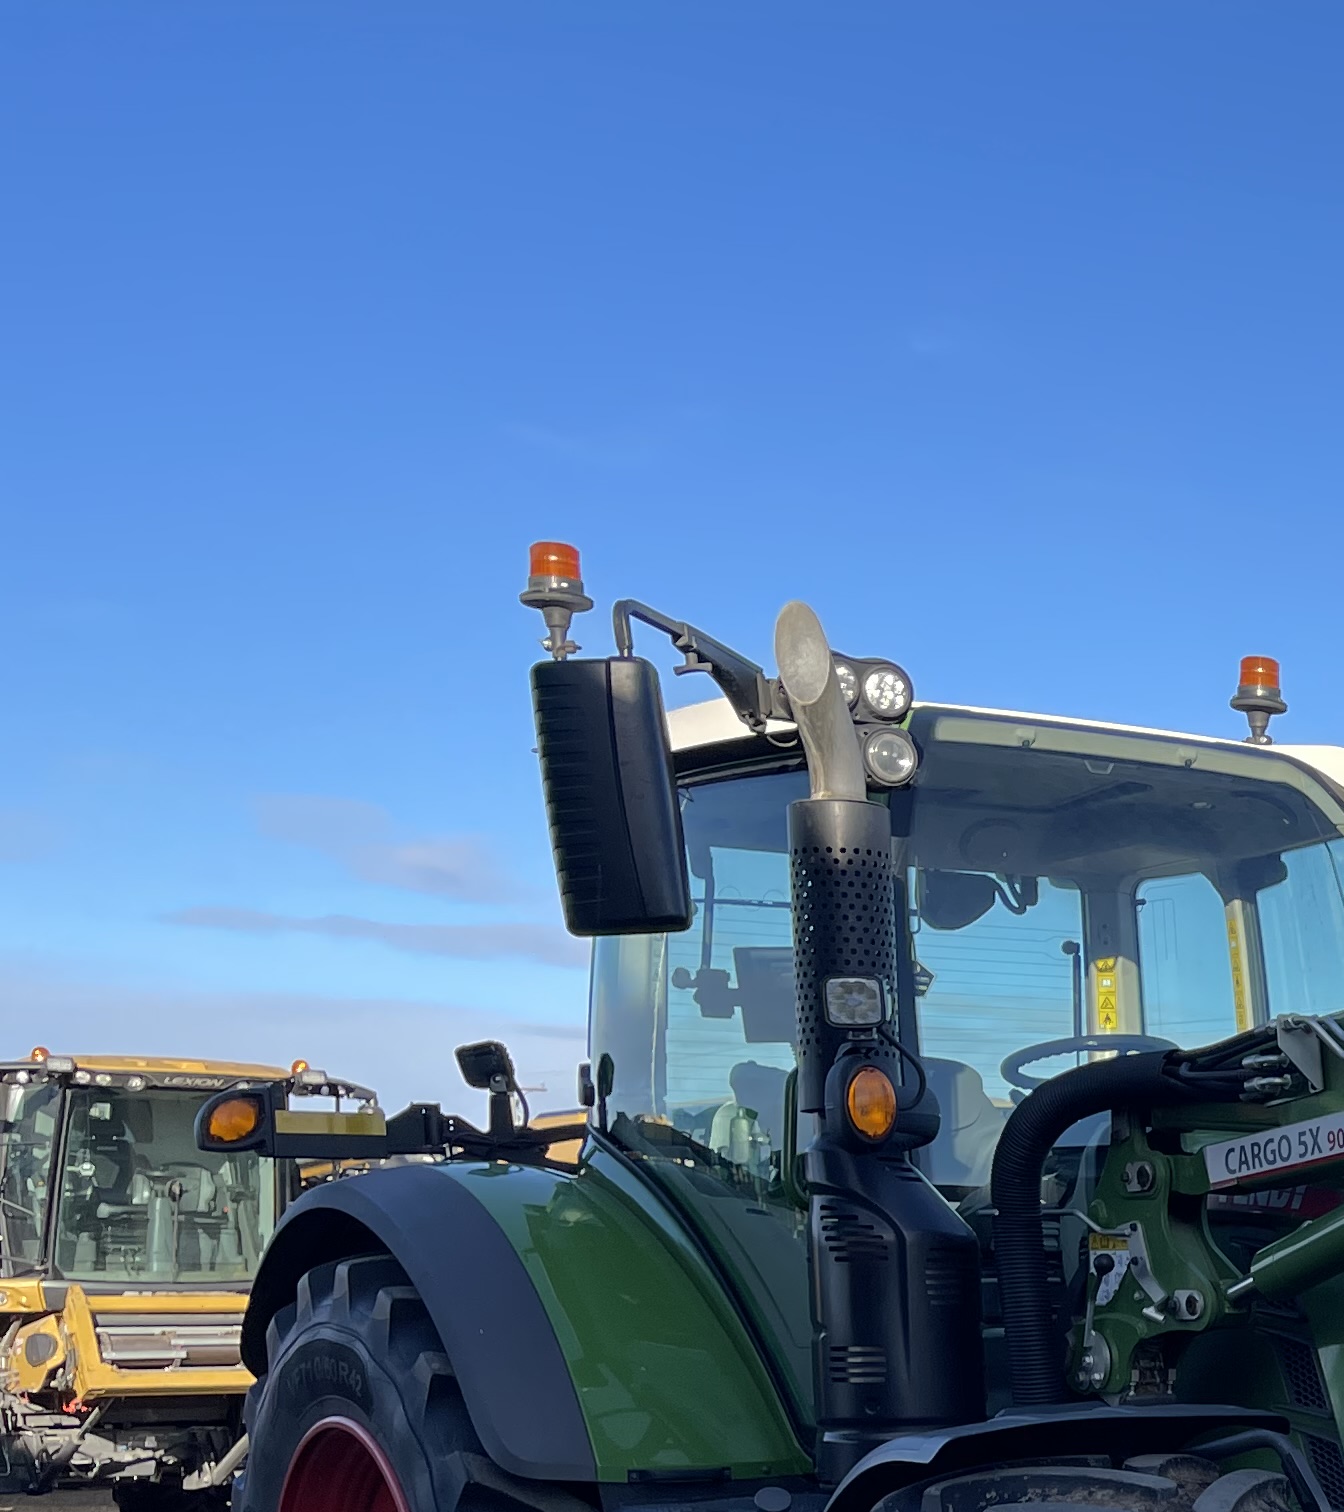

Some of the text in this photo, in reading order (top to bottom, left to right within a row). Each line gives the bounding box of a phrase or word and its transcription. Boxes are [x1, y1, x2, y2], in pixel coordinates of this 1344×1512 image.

[163, 1076, 225, 1087] LEXION
[1224, 1134, 1293, 1175] CARGO
[1298, 1126, 1323, 1158] 5X
